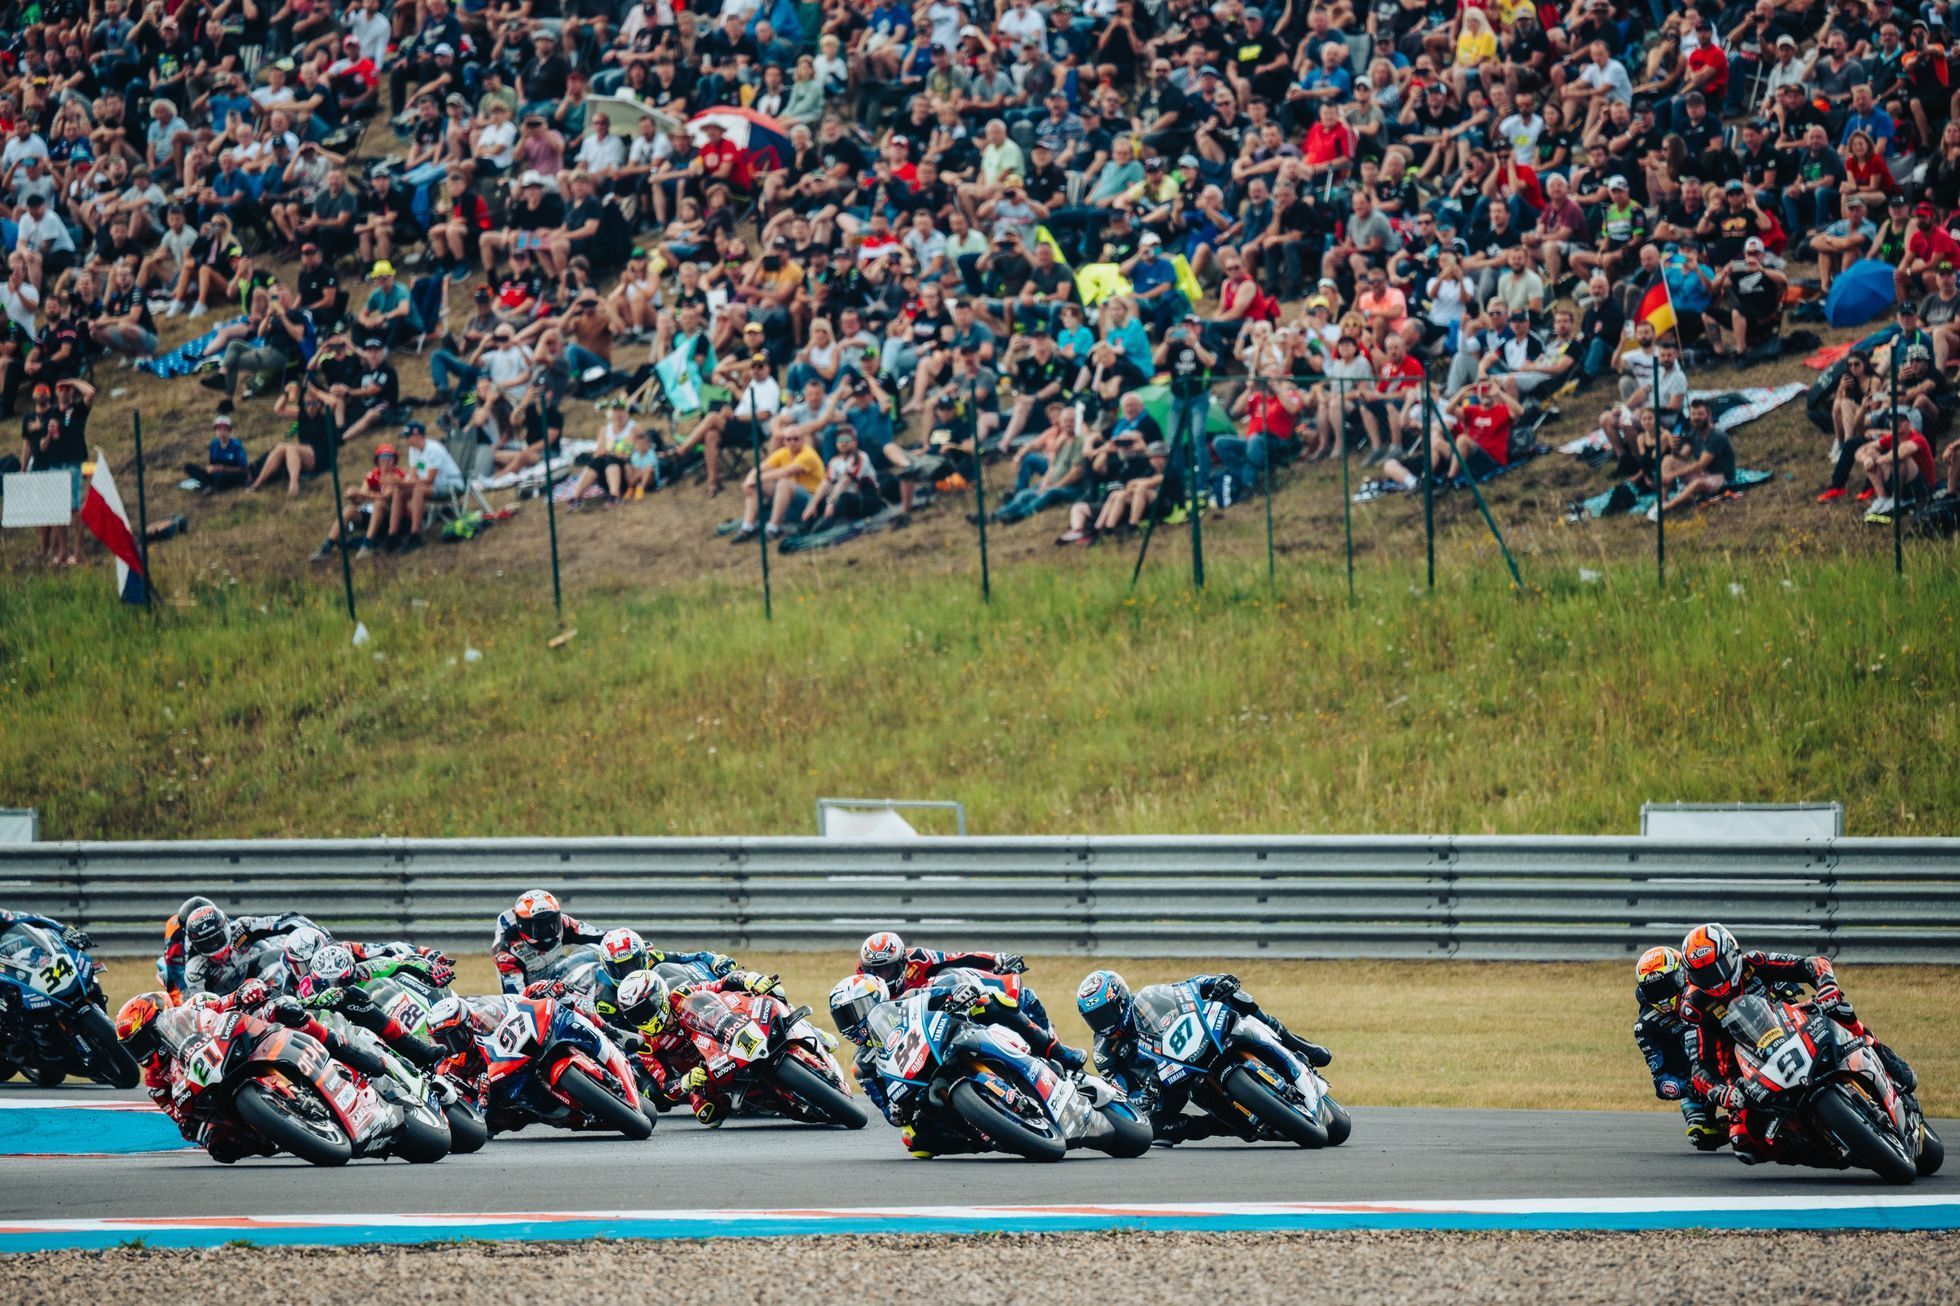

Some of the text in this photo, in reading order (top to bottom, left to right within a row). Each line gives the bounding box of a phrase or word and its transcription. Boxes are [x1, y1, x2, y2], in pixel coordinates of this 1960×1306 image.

[39, 957, 73, 994] 34
[760, 999, 772, 1024] Lenovo
[1215, 1010, 1227, 1031] YAMAHA
[221, 1014, 239, 1040] Lenovo
[499, 1012, 526, 1053] 97
[722, 1014, 750, 1052] aruba.it
[933, 1018, 949, 1041] YAMAHA
[1169, 1017, 1193, 1056] 87
[894, 1029, 920, 1073] 54
[911, 1053, 925, 1073] BMP
[193, 1046, 222, 1087] 21
[714, 1062, 736, 1079] Lenovo
[1167, 1069, 1187, 1085] YAMAHA
[176, 1090, 192, 1108] Lenovo
